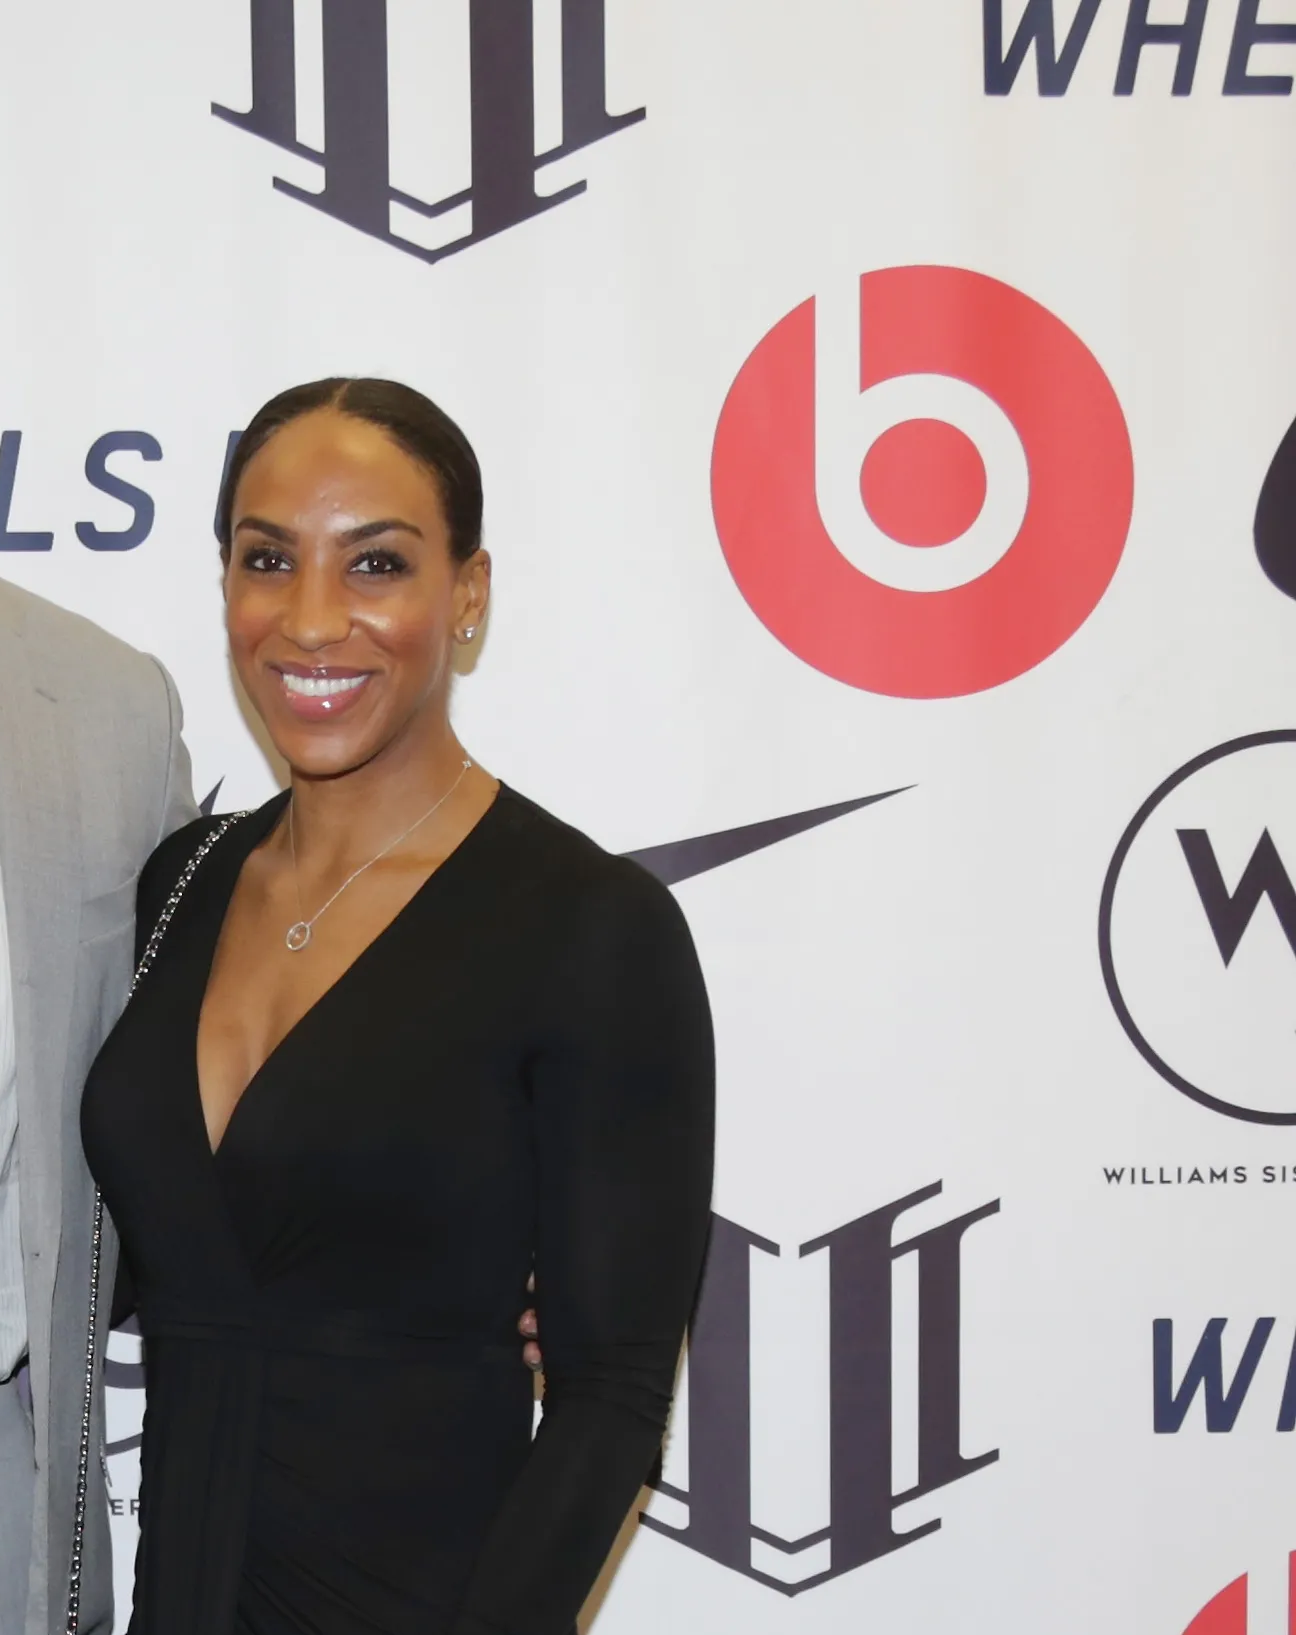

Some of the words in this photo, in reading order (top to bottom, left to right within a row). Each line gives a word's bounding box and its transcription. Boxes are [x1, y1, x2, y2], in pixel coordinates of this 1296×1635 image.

[1103, 1166, 1248, 1185] WILLIAMS
[1262, 1166, 1296, 1184] SI
[1152, 1317, 1296, 1434] W
